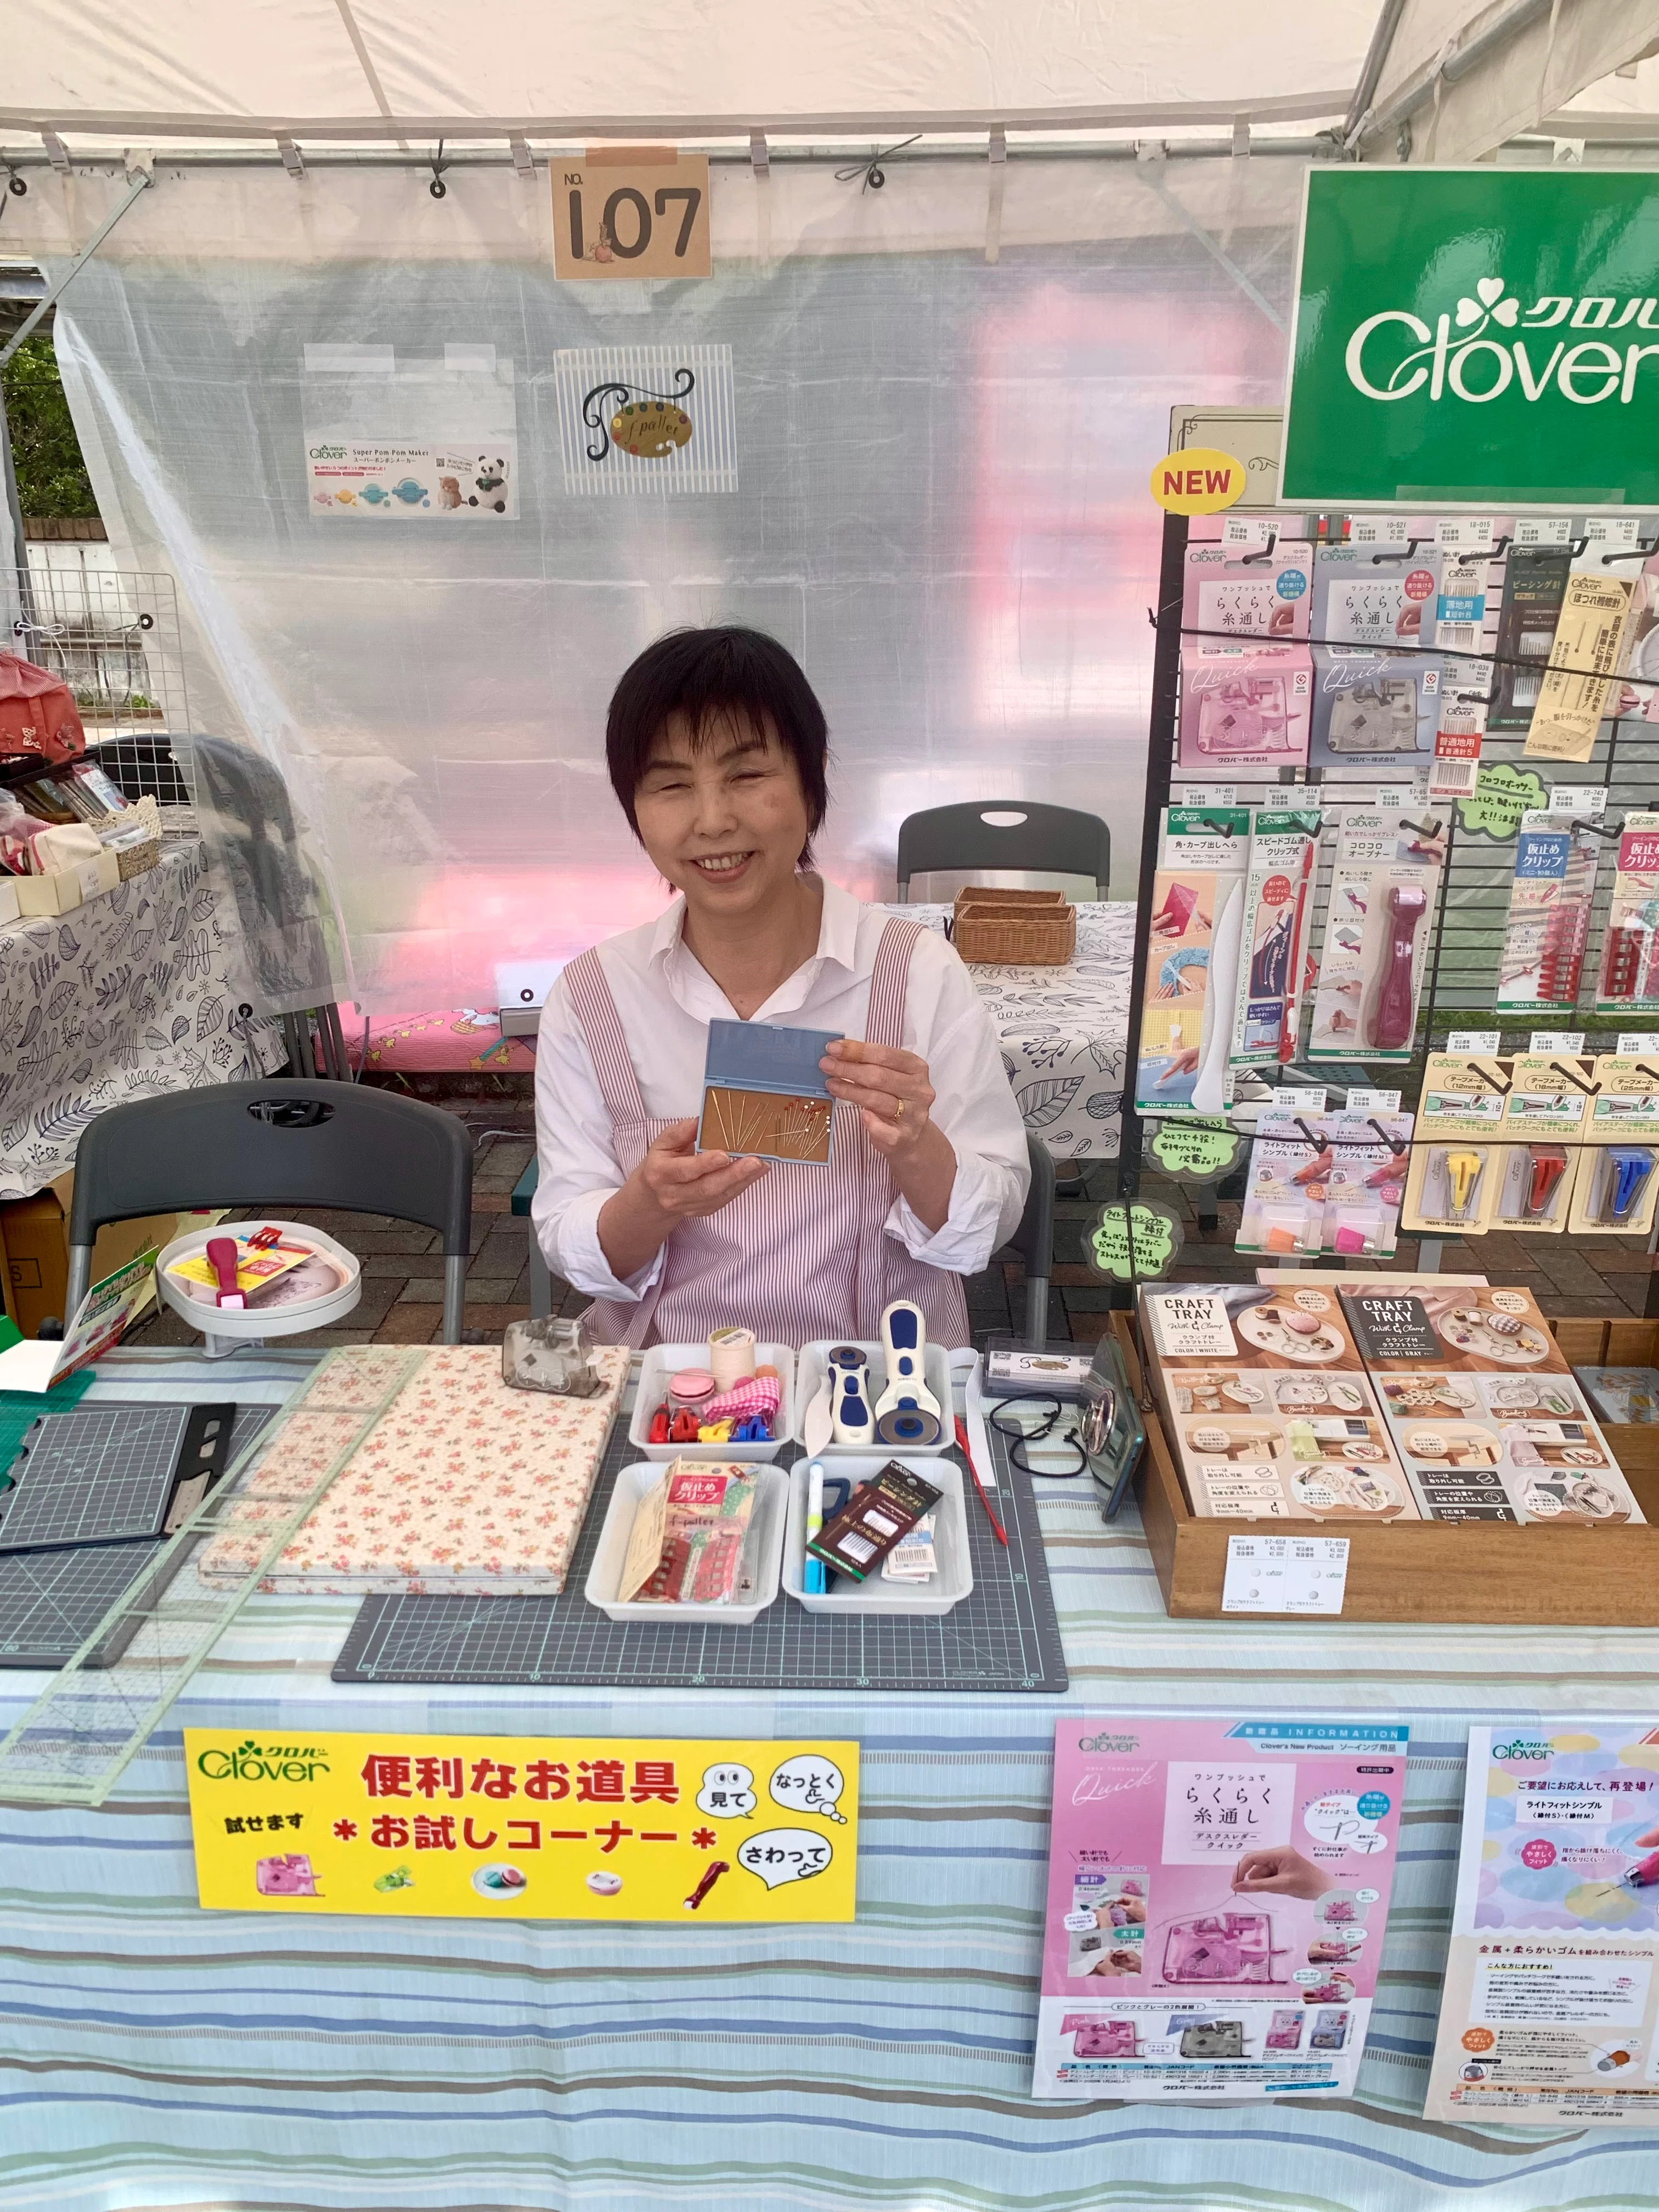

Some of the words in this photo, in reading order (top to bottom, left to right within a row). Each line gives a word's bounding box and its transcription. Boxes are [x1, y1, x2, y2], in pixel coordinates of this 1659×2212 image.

[564, 173, 584, 185] NO.
[569, 188, 701, 259] 107
[1345, 311, 1659, 404] Clover
[310, 448, 347, 459] Clover
[1164, 469, 1231, 495] NEW
[1190, 554, 1227, 562] Clover
[1321, 552, 1357, 562] Clover
[1572, 579, 1601, 590] Clover
[1217, 596, 1274, 610] らくらく
[1346, 596, 1402, 608] らくらく
[1573, 593, 1622, 609] ほつれ補修針
[1222, 612, 1267, 625] 糸通し
[1350, 611, 1394, 624] 糸通し
[1447, 708, 1474, 716] Clover
[1439, 737, 1475, 748] 普通地用
[1171, 814, 1200, 822] Clover
[1346, 817, 1382, 827] Clover
[1256, 837, 1311, 846] スピードゴム通し
[1267, 847, 1299, 855] クリップ式
[1527, 844, 1560, 855] 仮止め
[1522, 856, 1563, 867] クリップ
[1624, 857, 1659, 867] クリッ
[1433, 1060, 1463, 1068] Clover
[1164, 1299, 1214, 1309] CRAFT
[1363, 1301, 1413, 1311] CRAFT
[1172, 1310, 1212, 1319] TRAY
[1372, 1311, 1412, 1322] TRAY
[1369, 1324, 1392, 1333] With
[1402, 1324, 1425, 1333] Clamp
[674, 1491, 720, 1501] クリップ
[856, 1678, 870, 1687] 30
[1022, 1680, 1034, 1688] 40
[1288, 1728, 1399, 1740] INFORMATION
[1079, 1736, 1141, 1754] Clover
[1340, 1743, 1396, 1752] ソーイング用品
[1492, 1745, 1554, 1760] Clover
[198, 1749, 330, 1782] Clover
[360, 1753, 680, 1805] 便利なお道具
[776, 1774, 835, 1789] なっとく
[1072, 1761, 1159, 1807] Quick
[1518, 1781, 1654, 1792] ご要望にお応えして、再登場!
[709, 1792, 747, 1808] 見て
[1186, 1787, 1271, 1804] らくらく
[1193, 1808, 1260, 1825] 糸通し
[224, 1813, 304, 1835] 試せます
[370, 1814, 678, 1853] お試しコーナー
[746, 1847, 826, 1863] さわって
